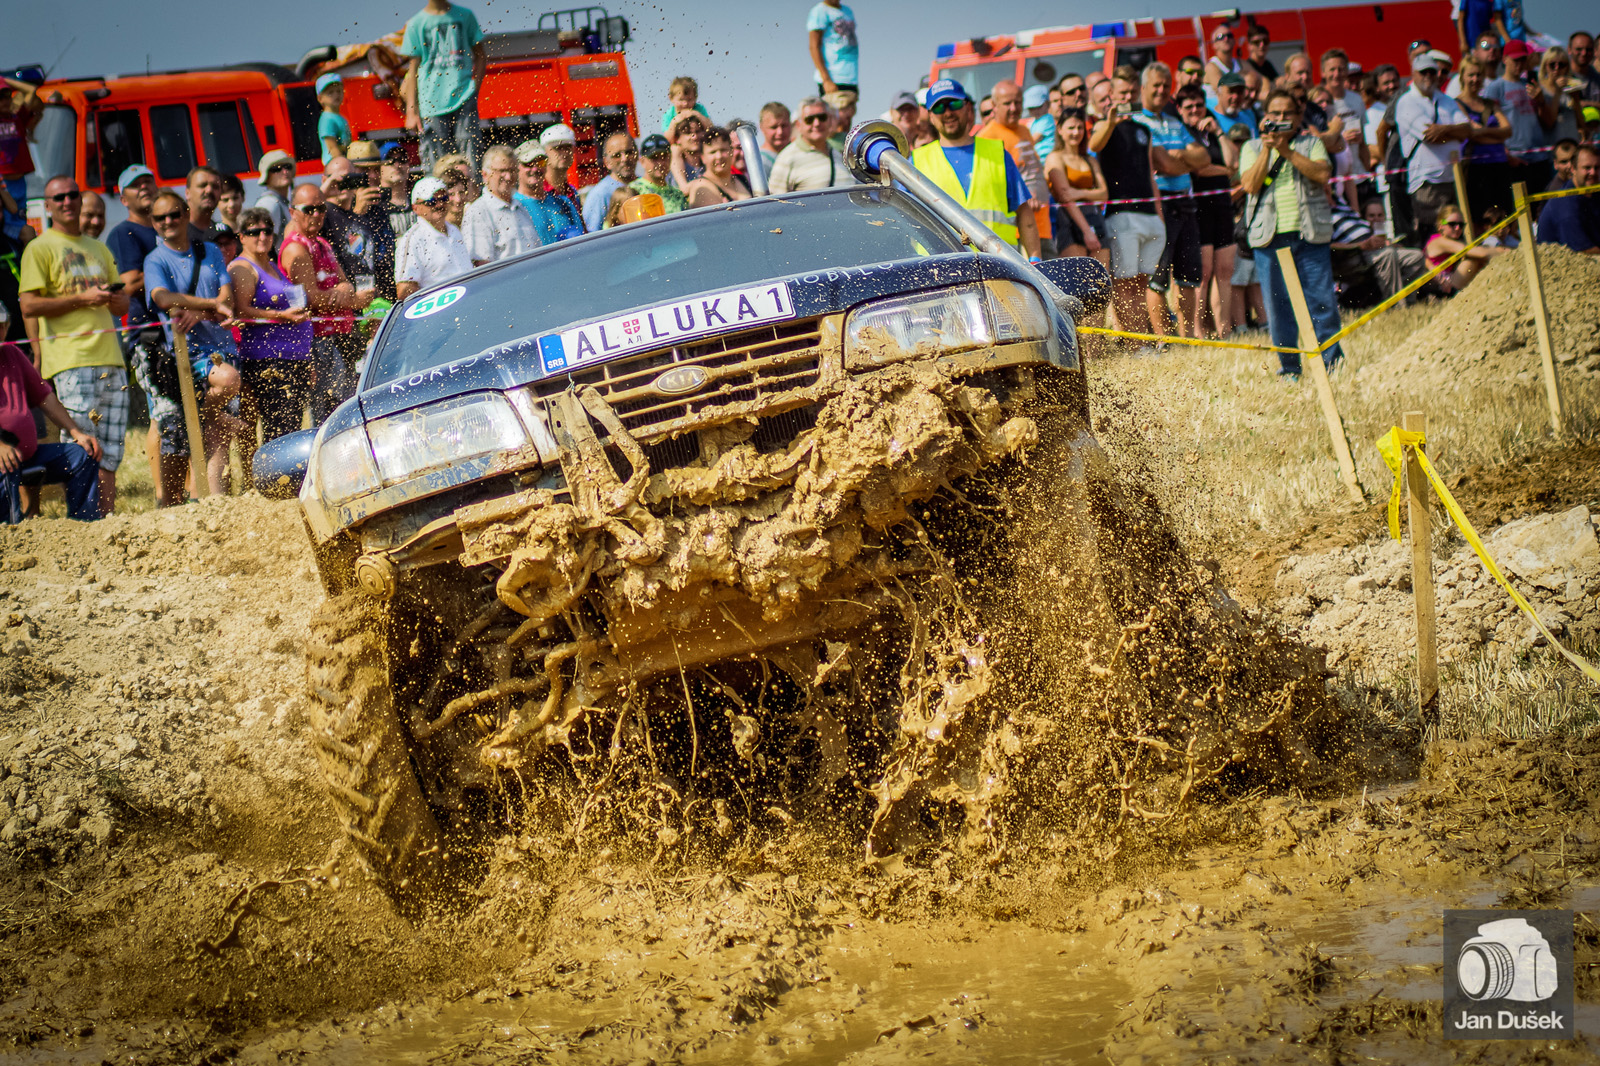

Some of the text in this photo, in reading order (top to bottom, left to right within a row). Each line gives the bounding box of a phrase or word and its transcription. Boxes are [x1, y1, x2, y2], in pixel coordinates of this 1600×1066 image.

[413, 289, 458, 315] 56
[576, 325, 621, 360] AL
[547, 357, 565, 370] SRB
